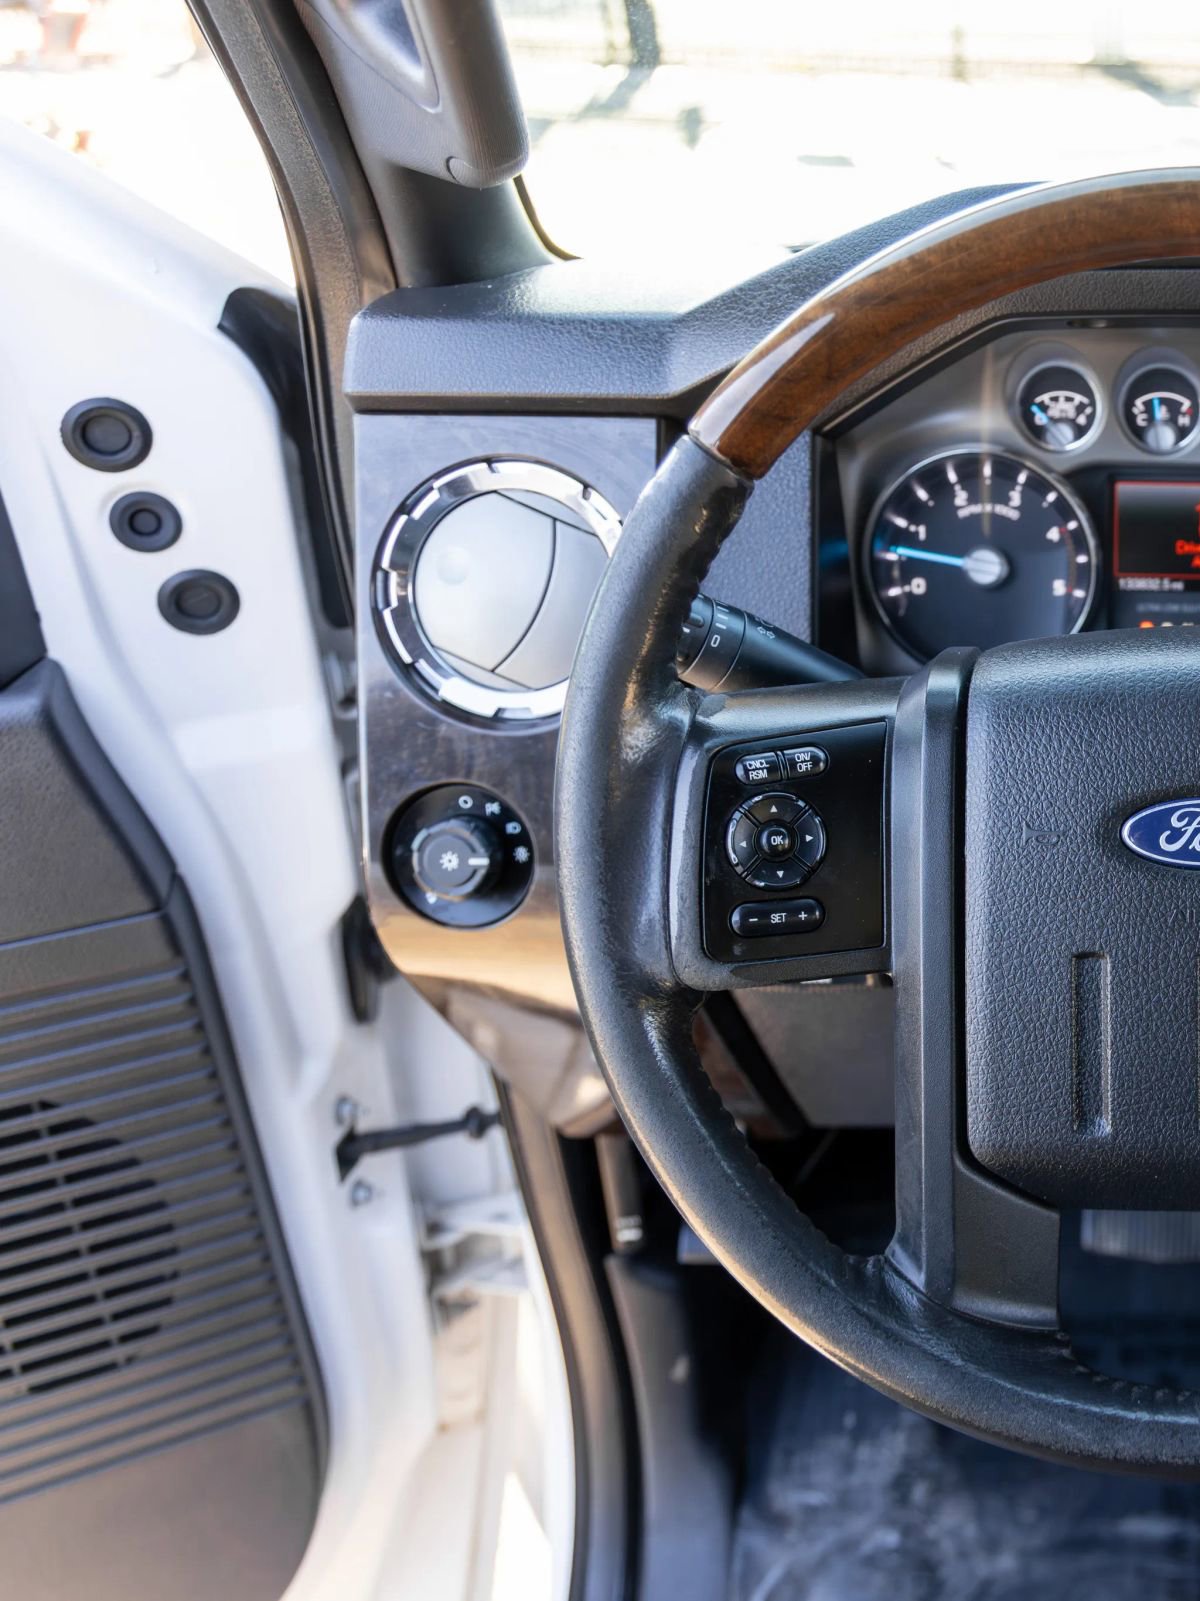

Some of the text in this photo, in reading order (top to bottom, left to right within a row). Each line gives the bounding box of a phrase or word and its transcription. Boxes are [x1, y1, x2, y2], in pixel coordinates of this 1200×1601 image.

[954, 489, 968, 507] 2
[1009, 490, 1021, 507] 3
[1046, 526, 1060, 543] 4
[910, 577, 927, 595] 0
[1052, 578, 1066, 597] 5
[795, 751, 811, 762] ON/
[746, 760, 770, 770] CNCL
[797, 761, 813, 773] OFF
[749, 769, 768, 780] RSM
[770, 835, 784, 846] OK
[770, 912, 787, 924] SET
